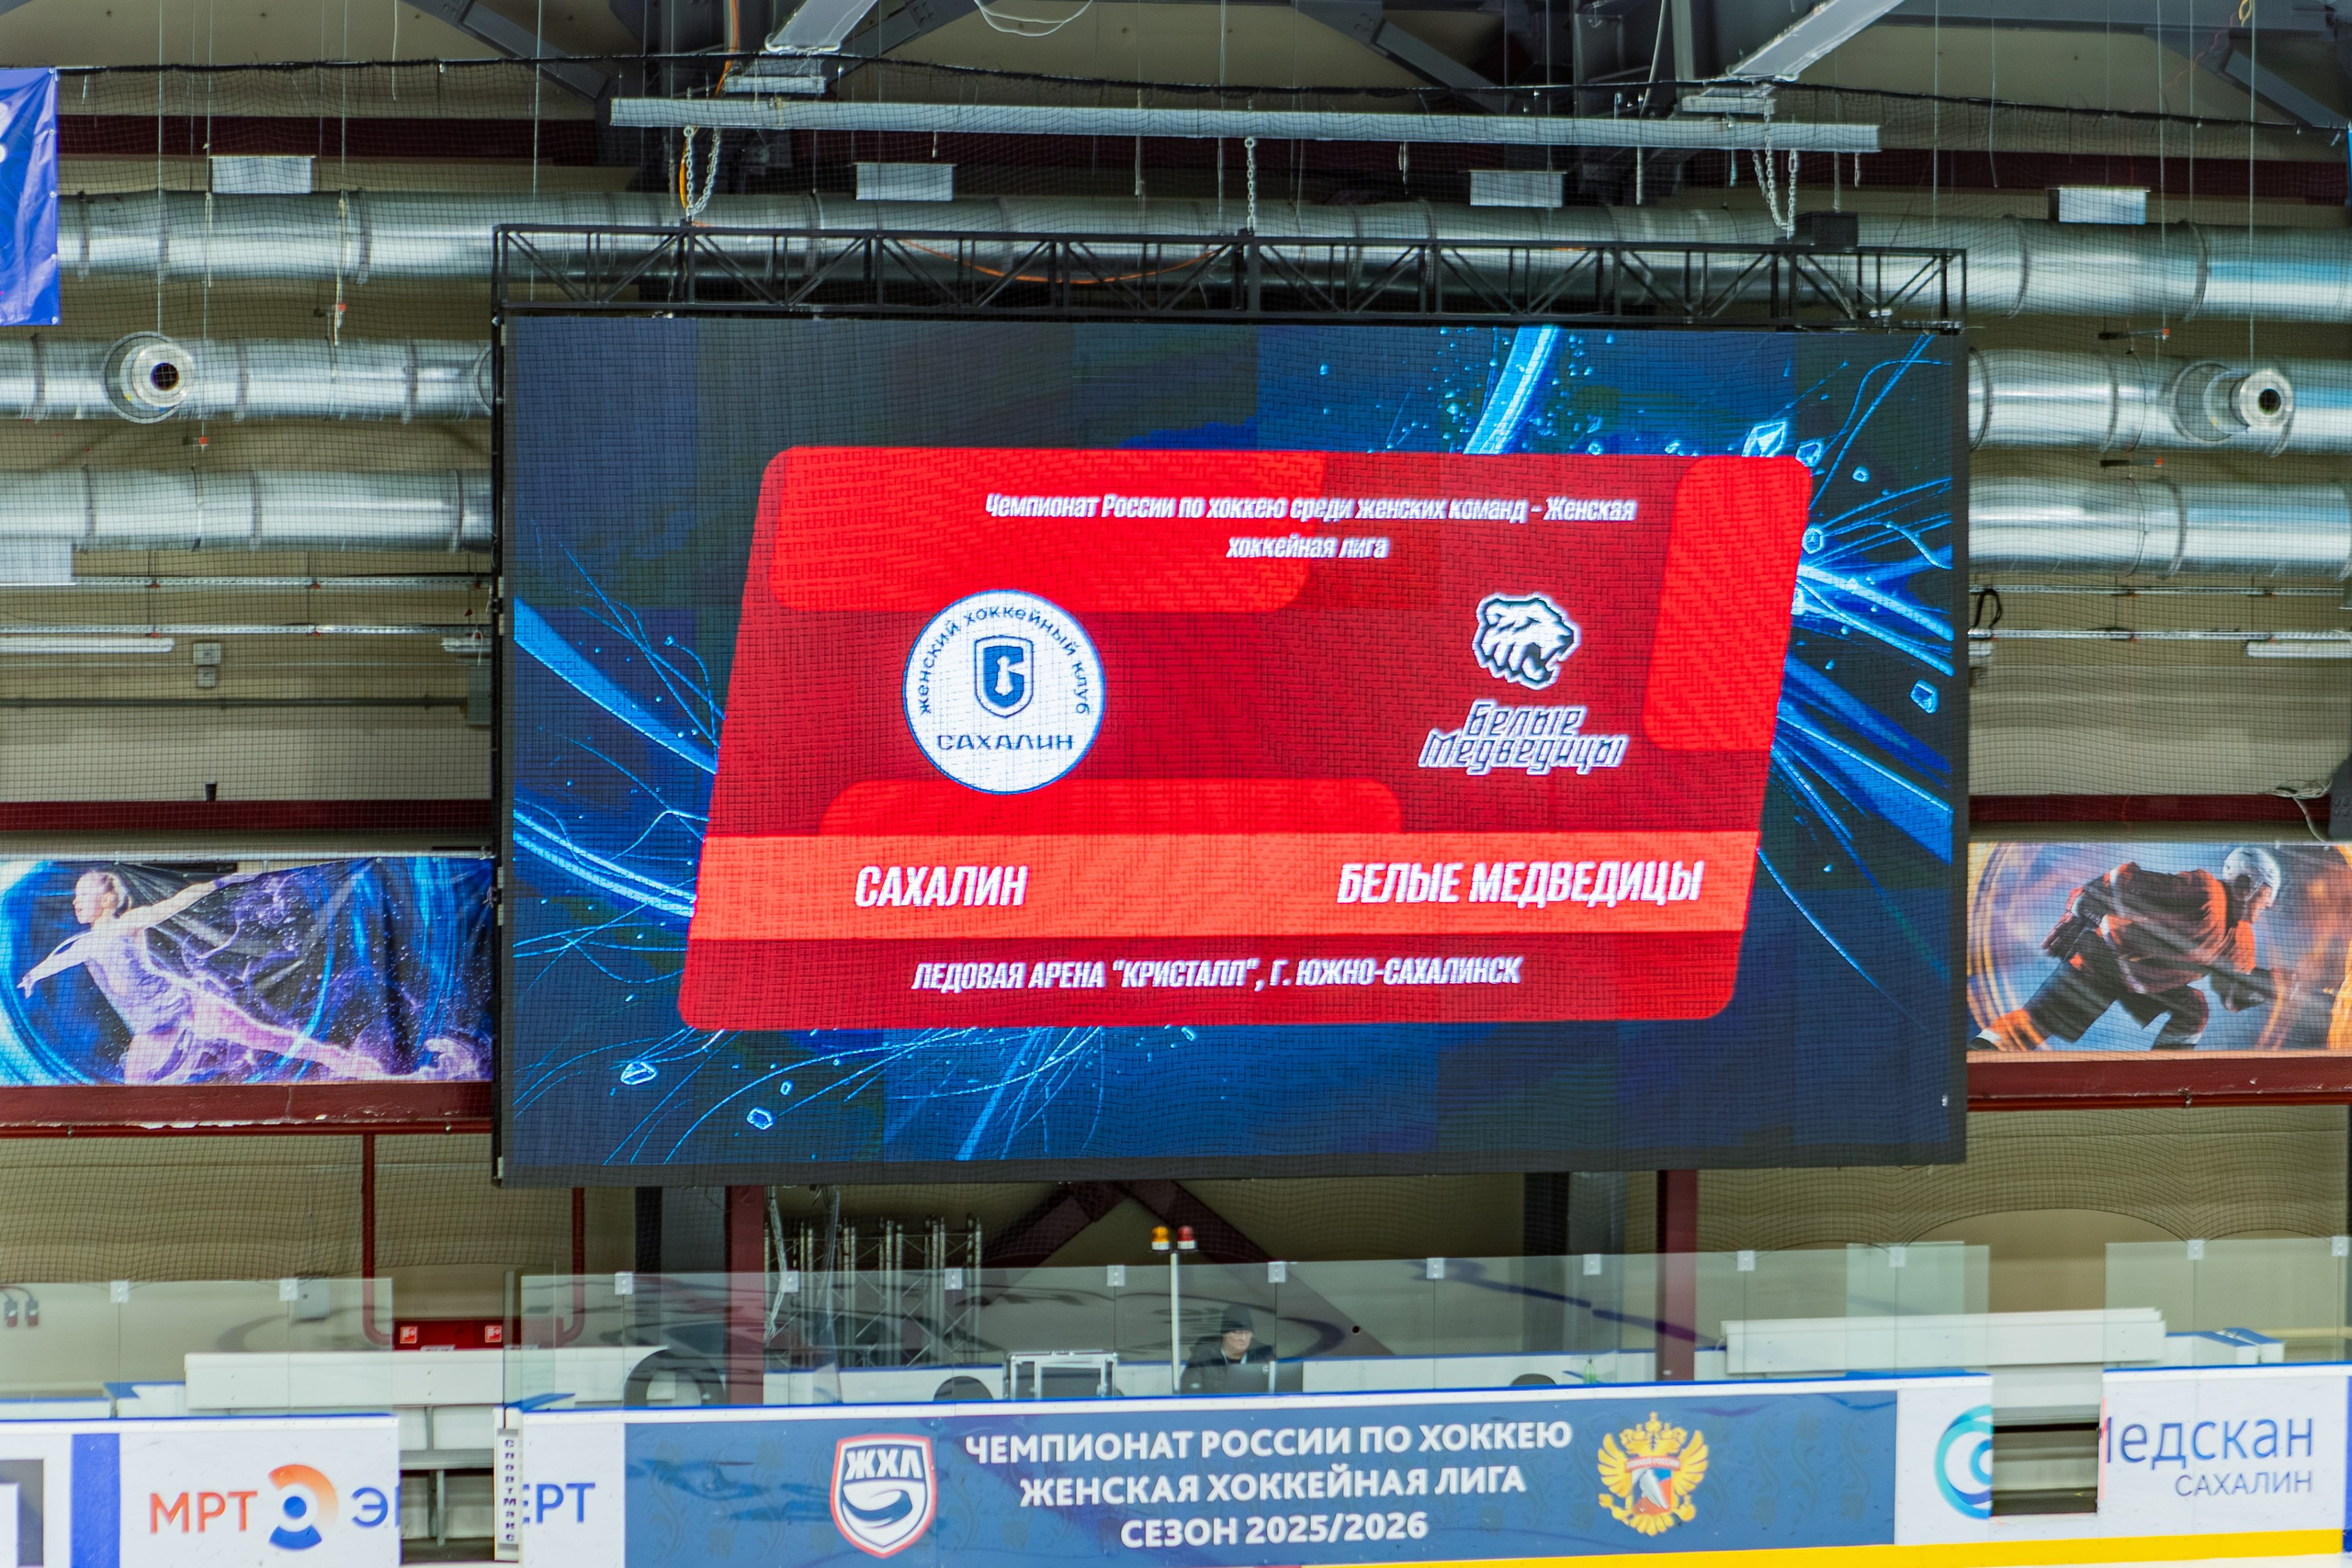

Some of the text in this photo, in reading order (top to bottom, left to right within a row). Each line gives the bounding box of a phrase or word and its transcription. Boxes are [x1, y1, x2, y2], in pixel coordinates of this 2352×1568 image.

[985, 492, 1100, 518] Чемпионат
[1101, 494, 1177, 518] России
[1178, 497, 1206, 518] по
[1206, 497, 1288, 519] хоккею
[1289, 498, 1354, 522] среди
[1355, 499, 1449, 520] женских
[1448, 499, 1529, 524] команд
[1544, 496, 1638, 521] Женская
[1226, 532, 1391, 558] хоккейная лига
[937, 734, 1073, 750] САХАЛИН
[854, 865, 1029, 907] САХАЛИН
[1337, 860, 1705, 908] БЕЛЫЕ МЕДВЕДИЦЫ
[910, 956, 1524, 994] ЛЕДОВАЯ АРЕНА "КРИСТАЛЛ", Г. ЮЖНО-САХАЛИНСК
[966, 1421, 1573, 1464] ЧЕМПИОНАТ РОССИИ ПО ХОККЕЮ
[844, 1448, 922, 1481] ЖХЛ
[1019, 1463, 1528, 1507] ЖЕНСКАЯ ХОККЕЙНАЯ ЛИГА
[2174, 1470, 2313, 1498] САХАЛИН
[149, 1486, 401, 1535] МРТ Э
[1120, 1511, 1430, 1549] СЕЗОН 2025/2026
